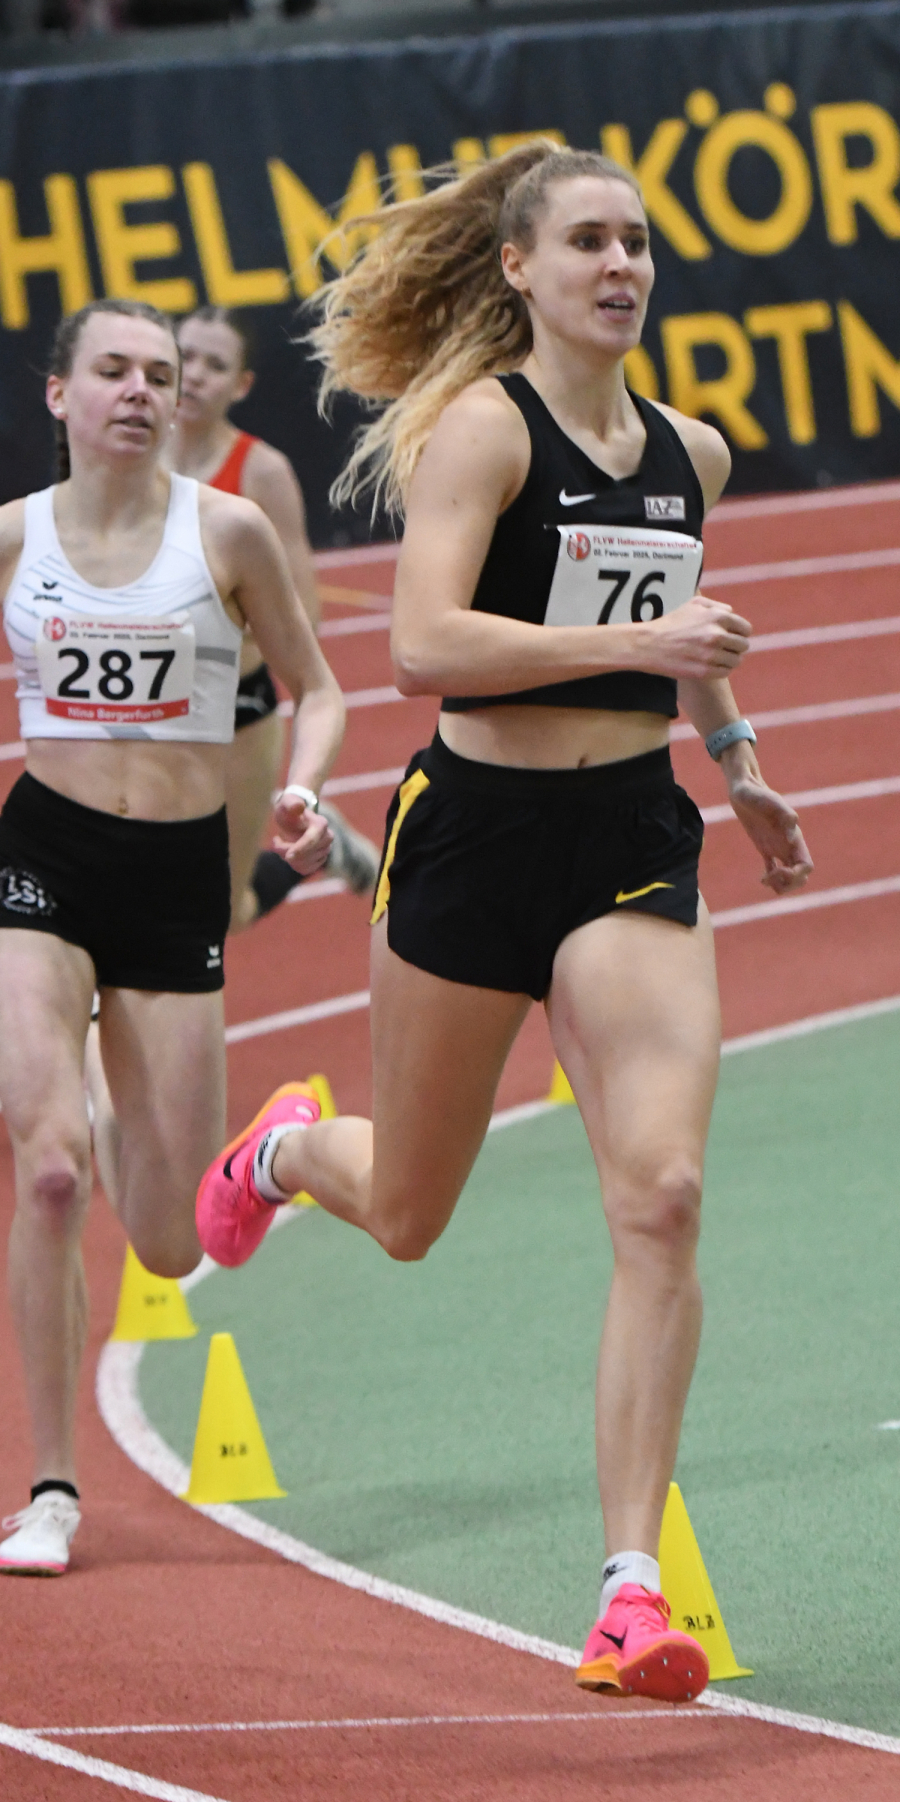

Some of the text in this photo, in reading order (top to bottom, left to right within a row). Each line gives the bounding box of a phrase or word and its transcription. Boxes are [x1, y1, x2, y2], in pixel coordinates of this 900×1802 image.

[0, 128, 566, 330] HELM
[597, 569, 665, 625] 76
[57, 648, 176, 701] 287
